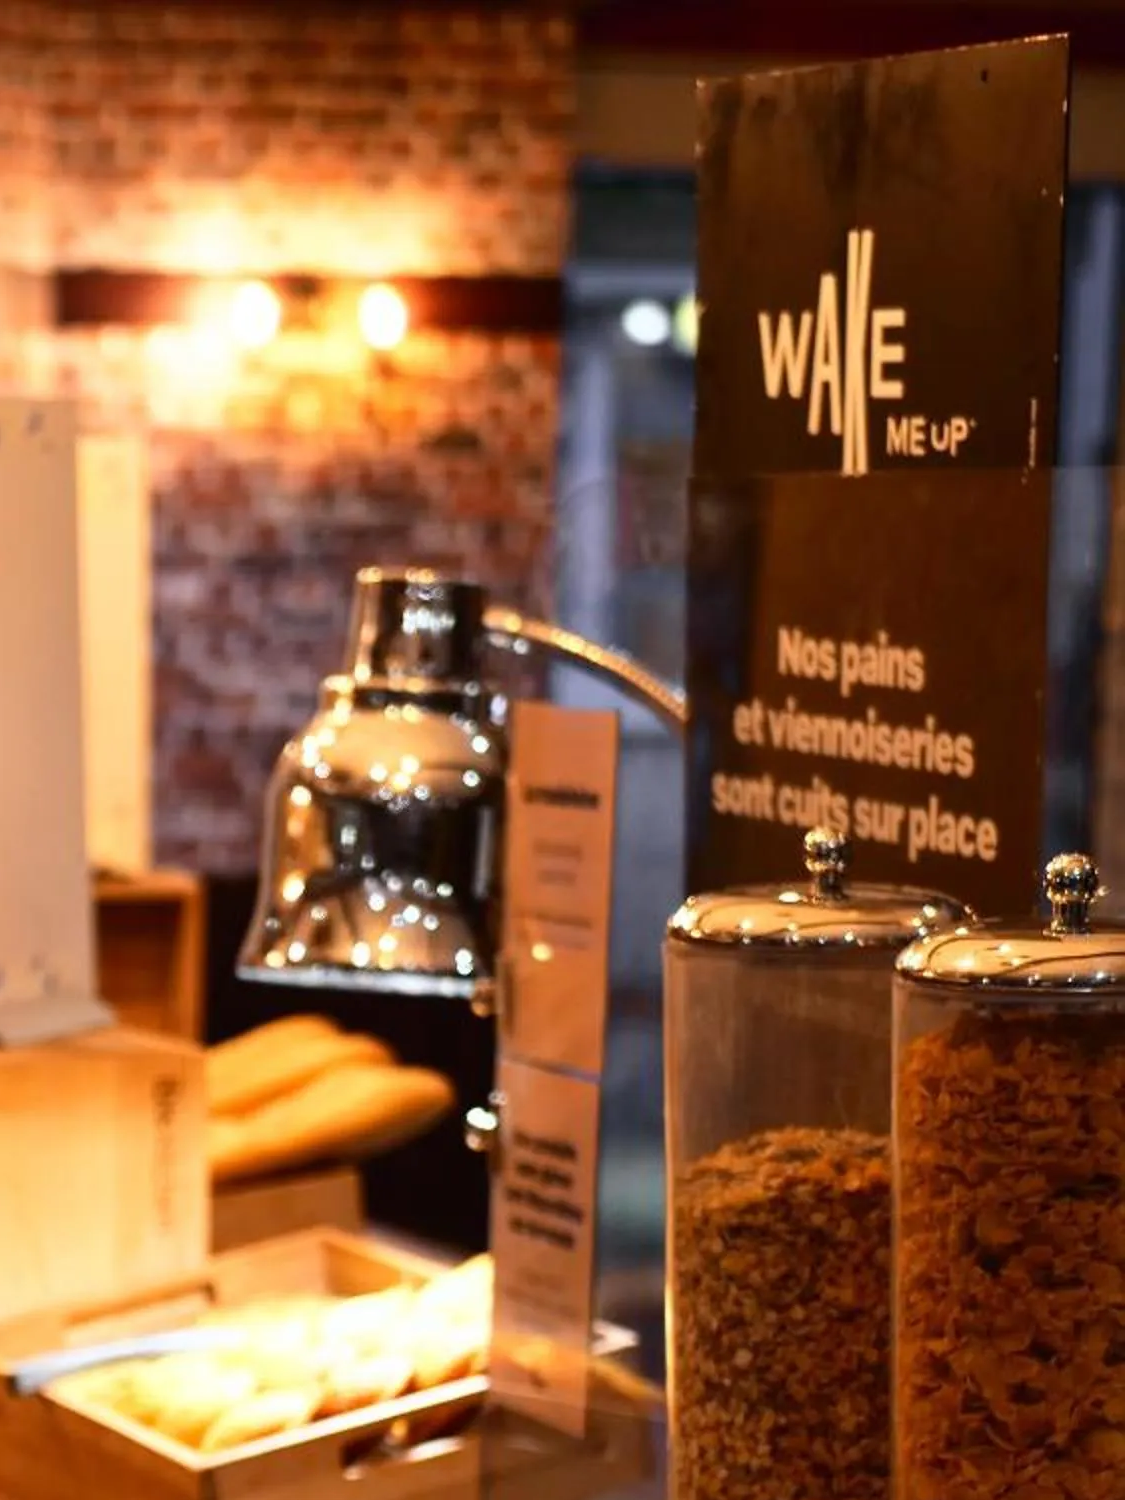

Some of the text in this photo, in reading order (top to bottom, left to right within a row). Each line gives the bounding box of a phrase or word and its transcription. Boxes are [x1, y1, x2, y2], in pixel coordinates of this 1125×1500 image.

[758, 229, 905, 476] WAKE
[886, 416, 926, 456] ME
[778, 627, 925, 697] Nos pains
[733, 695, 975, 779] et viennoiseries
[711, 773, 998, 863] sont cuits sur place
